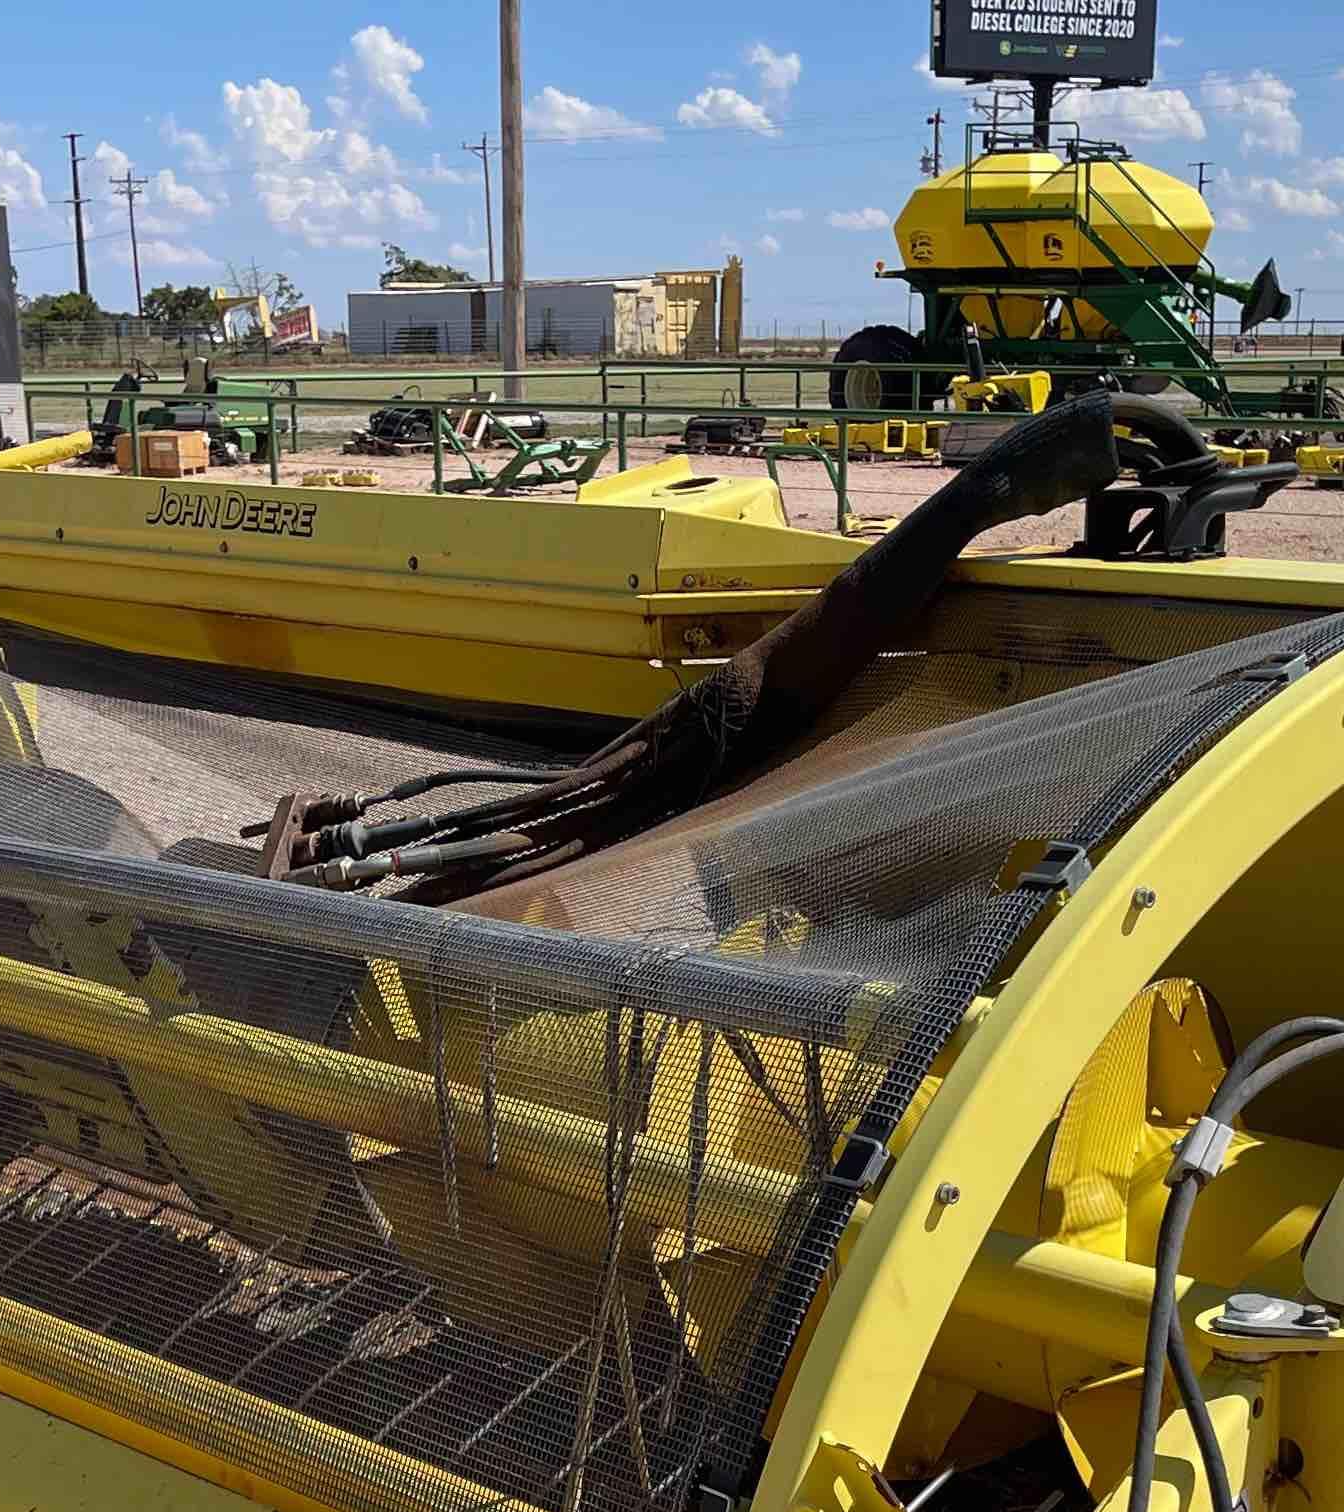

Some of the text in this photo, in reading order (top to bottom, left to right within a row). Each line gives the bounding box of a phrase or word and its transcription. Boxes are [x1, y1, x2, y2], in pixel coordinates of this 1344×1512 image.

[1027, 0, 1087, 14] STUDENTS
[1089, 0, 1118, 16] SENT
[1121, 0, 1136, 17] TO
[971, 11, 1135, 39] DIESEL COLLEGE SINCE 2020
[146, 486, 317, 538] JOHN DEERE
